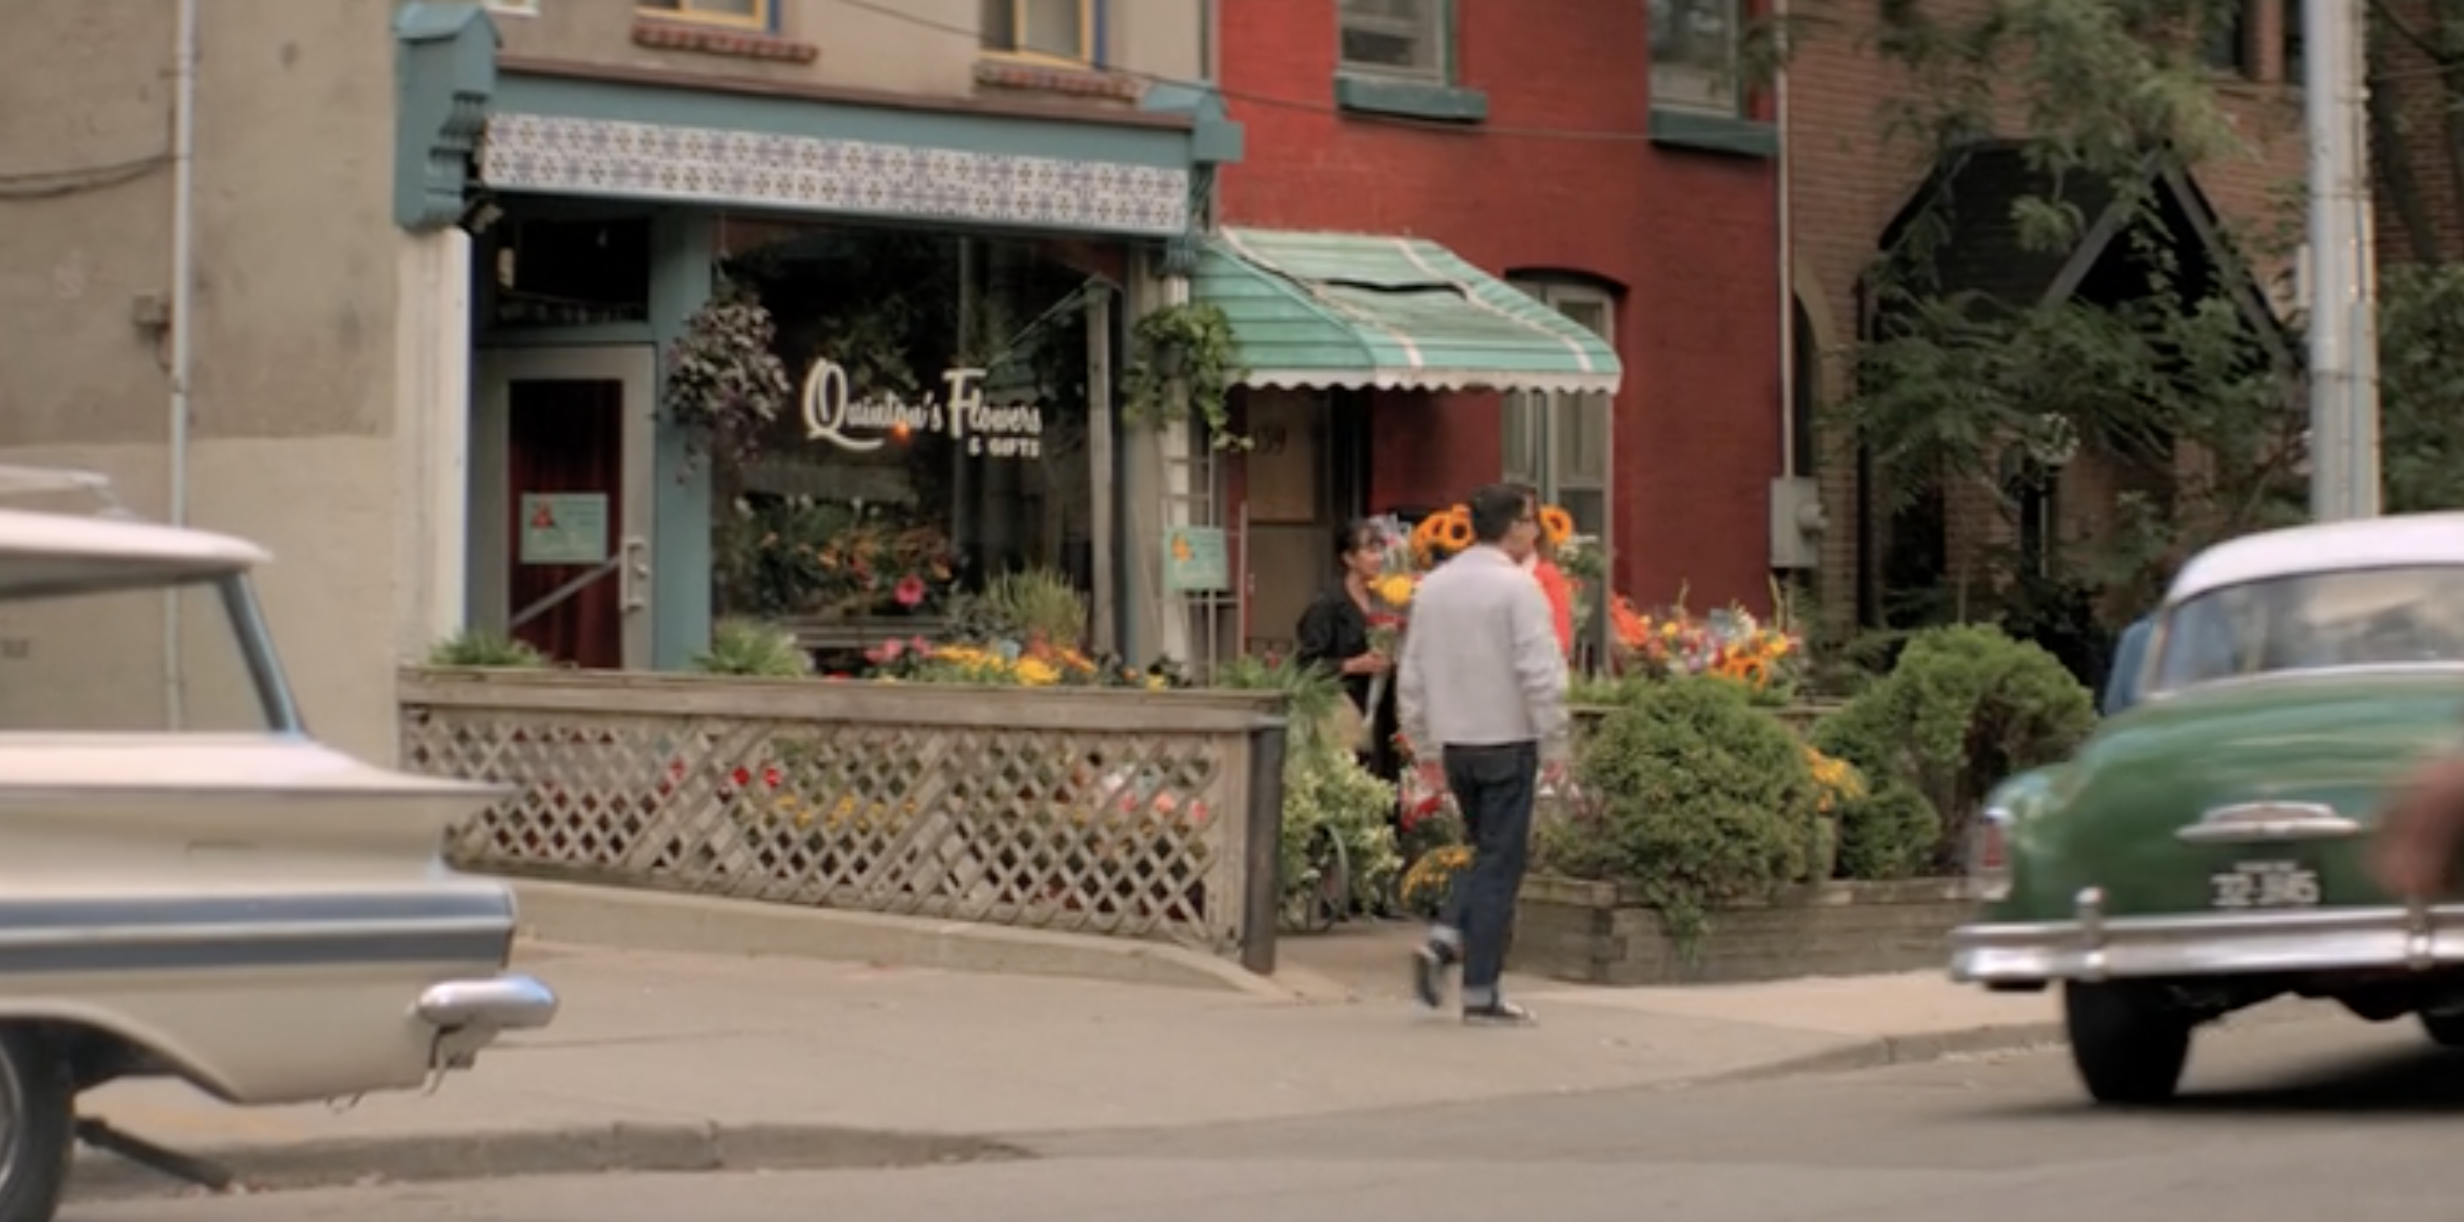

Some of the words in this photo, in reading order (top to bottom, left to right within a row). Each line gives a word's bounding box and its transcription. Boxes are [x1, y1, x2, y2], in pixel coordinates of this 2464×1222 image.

[804, 357, 942, 449] Quinton's
[942, 368, 1042, 439] Flowers
[968, 437, 981, 456] &
[987, 437, 1040, 457] GIFTS
